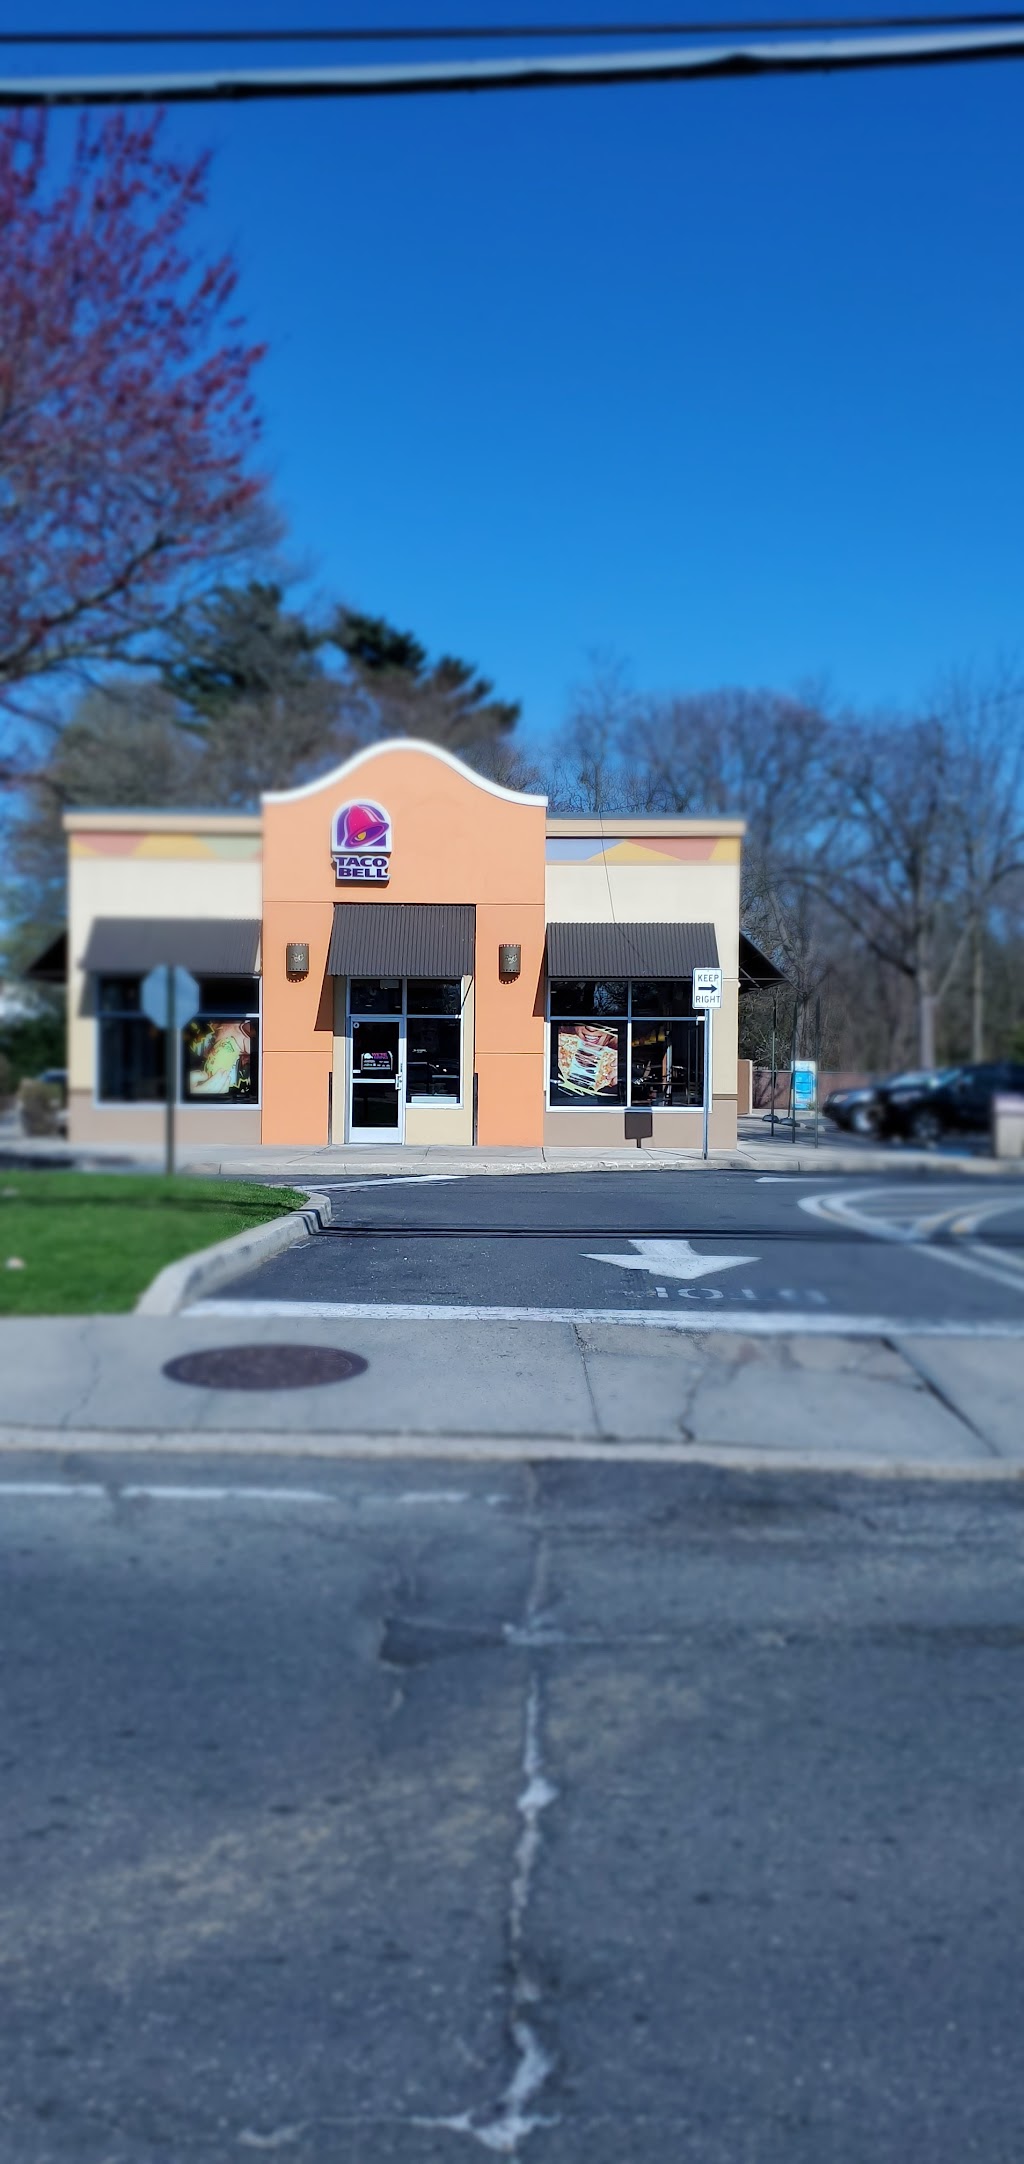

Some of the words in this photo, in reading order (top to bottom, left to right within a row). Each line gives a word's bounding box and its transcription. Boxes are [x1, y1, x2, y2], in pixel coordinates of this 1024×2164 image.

[335, 857, 388, 867] TACO
[339, 867, 388, 878] BELL
[697, 974, 719, 983] KEEP
[695, 995, 721, 1003] RIGHT
